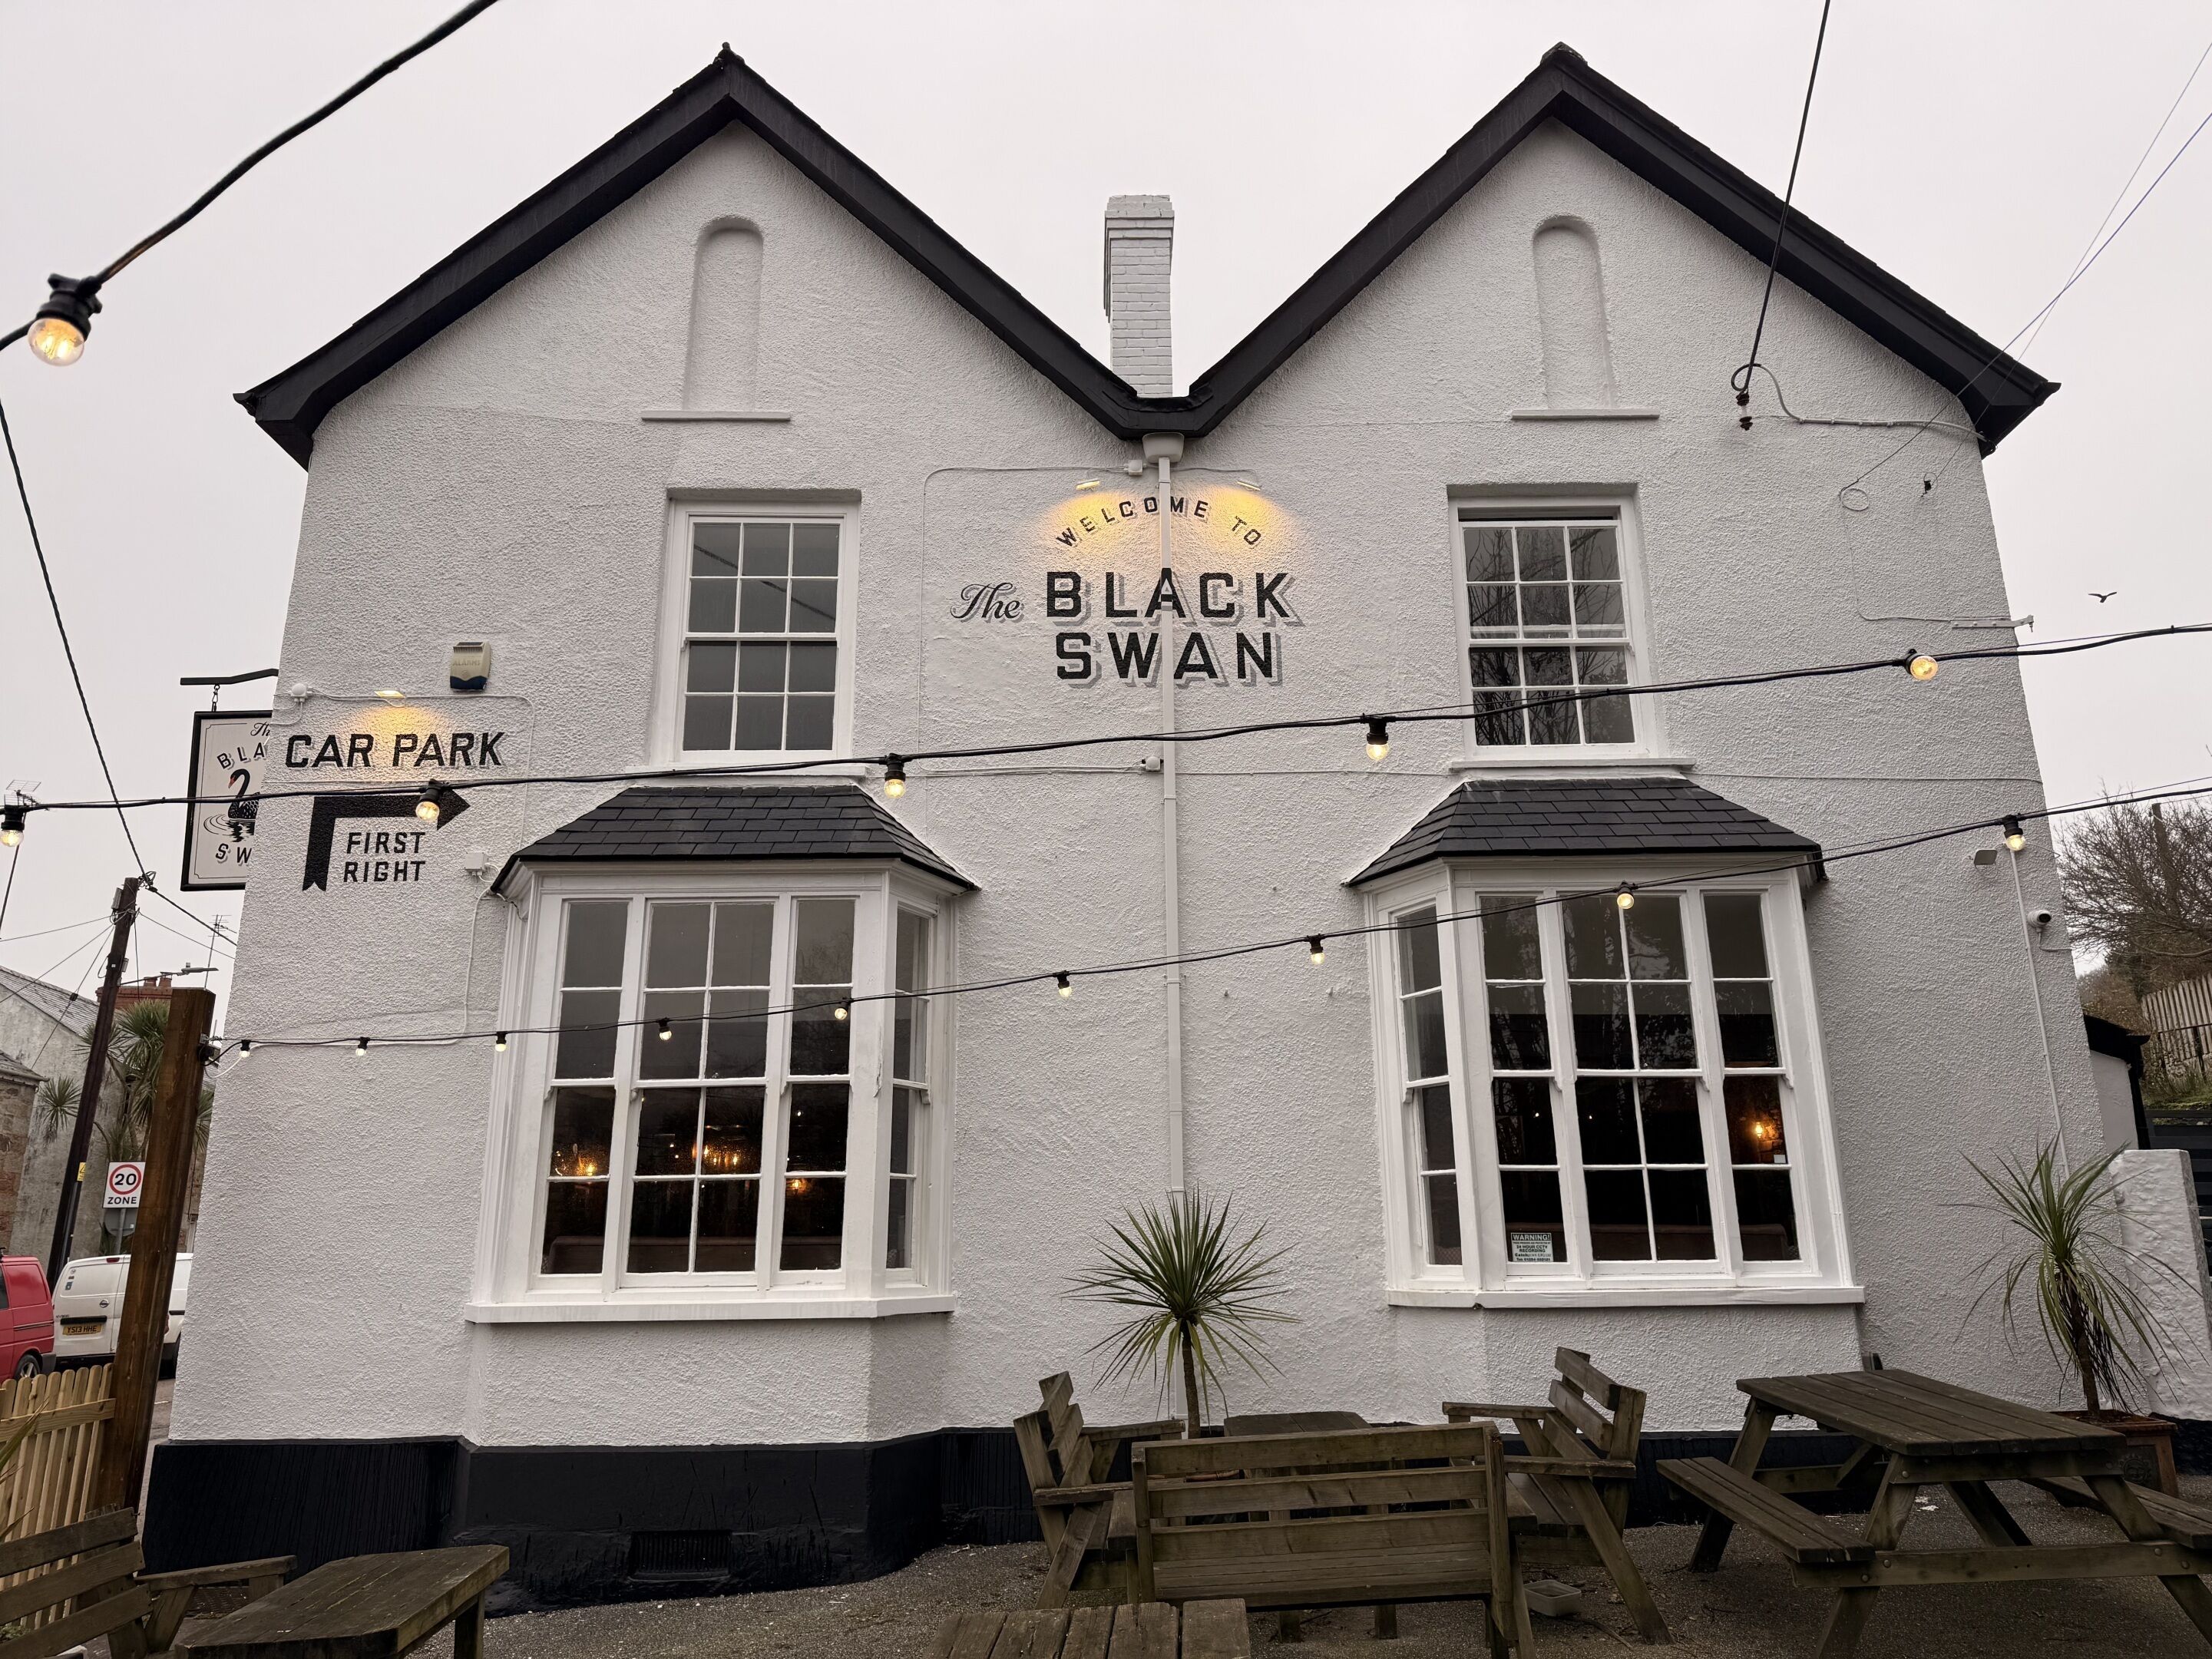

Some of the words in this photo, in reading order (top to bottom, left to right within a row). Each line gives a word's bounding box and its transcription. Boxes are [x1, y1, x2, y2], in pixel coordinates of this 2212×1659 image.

[1056, 497, 1208, 547] WELCOME
[1235, 515, 1261, 545] TO
[951, 583, 1021, 620] The
[1046, 568, 1291, 619] BLACK
[1056, 632, 1274, 679] SWAN
[250, 722, 270, 737] Th
[217, 742, 266, 769] BLA
[285, 734, 374, 768] CAR
[392, 732, 505, 767] PARK
[216, 843, 253, 864] SW
[346, 831, 426, 854] FIRST
[343, 861, 426, 883] RIGHT
[114, 1173, 137, 1185] 20
